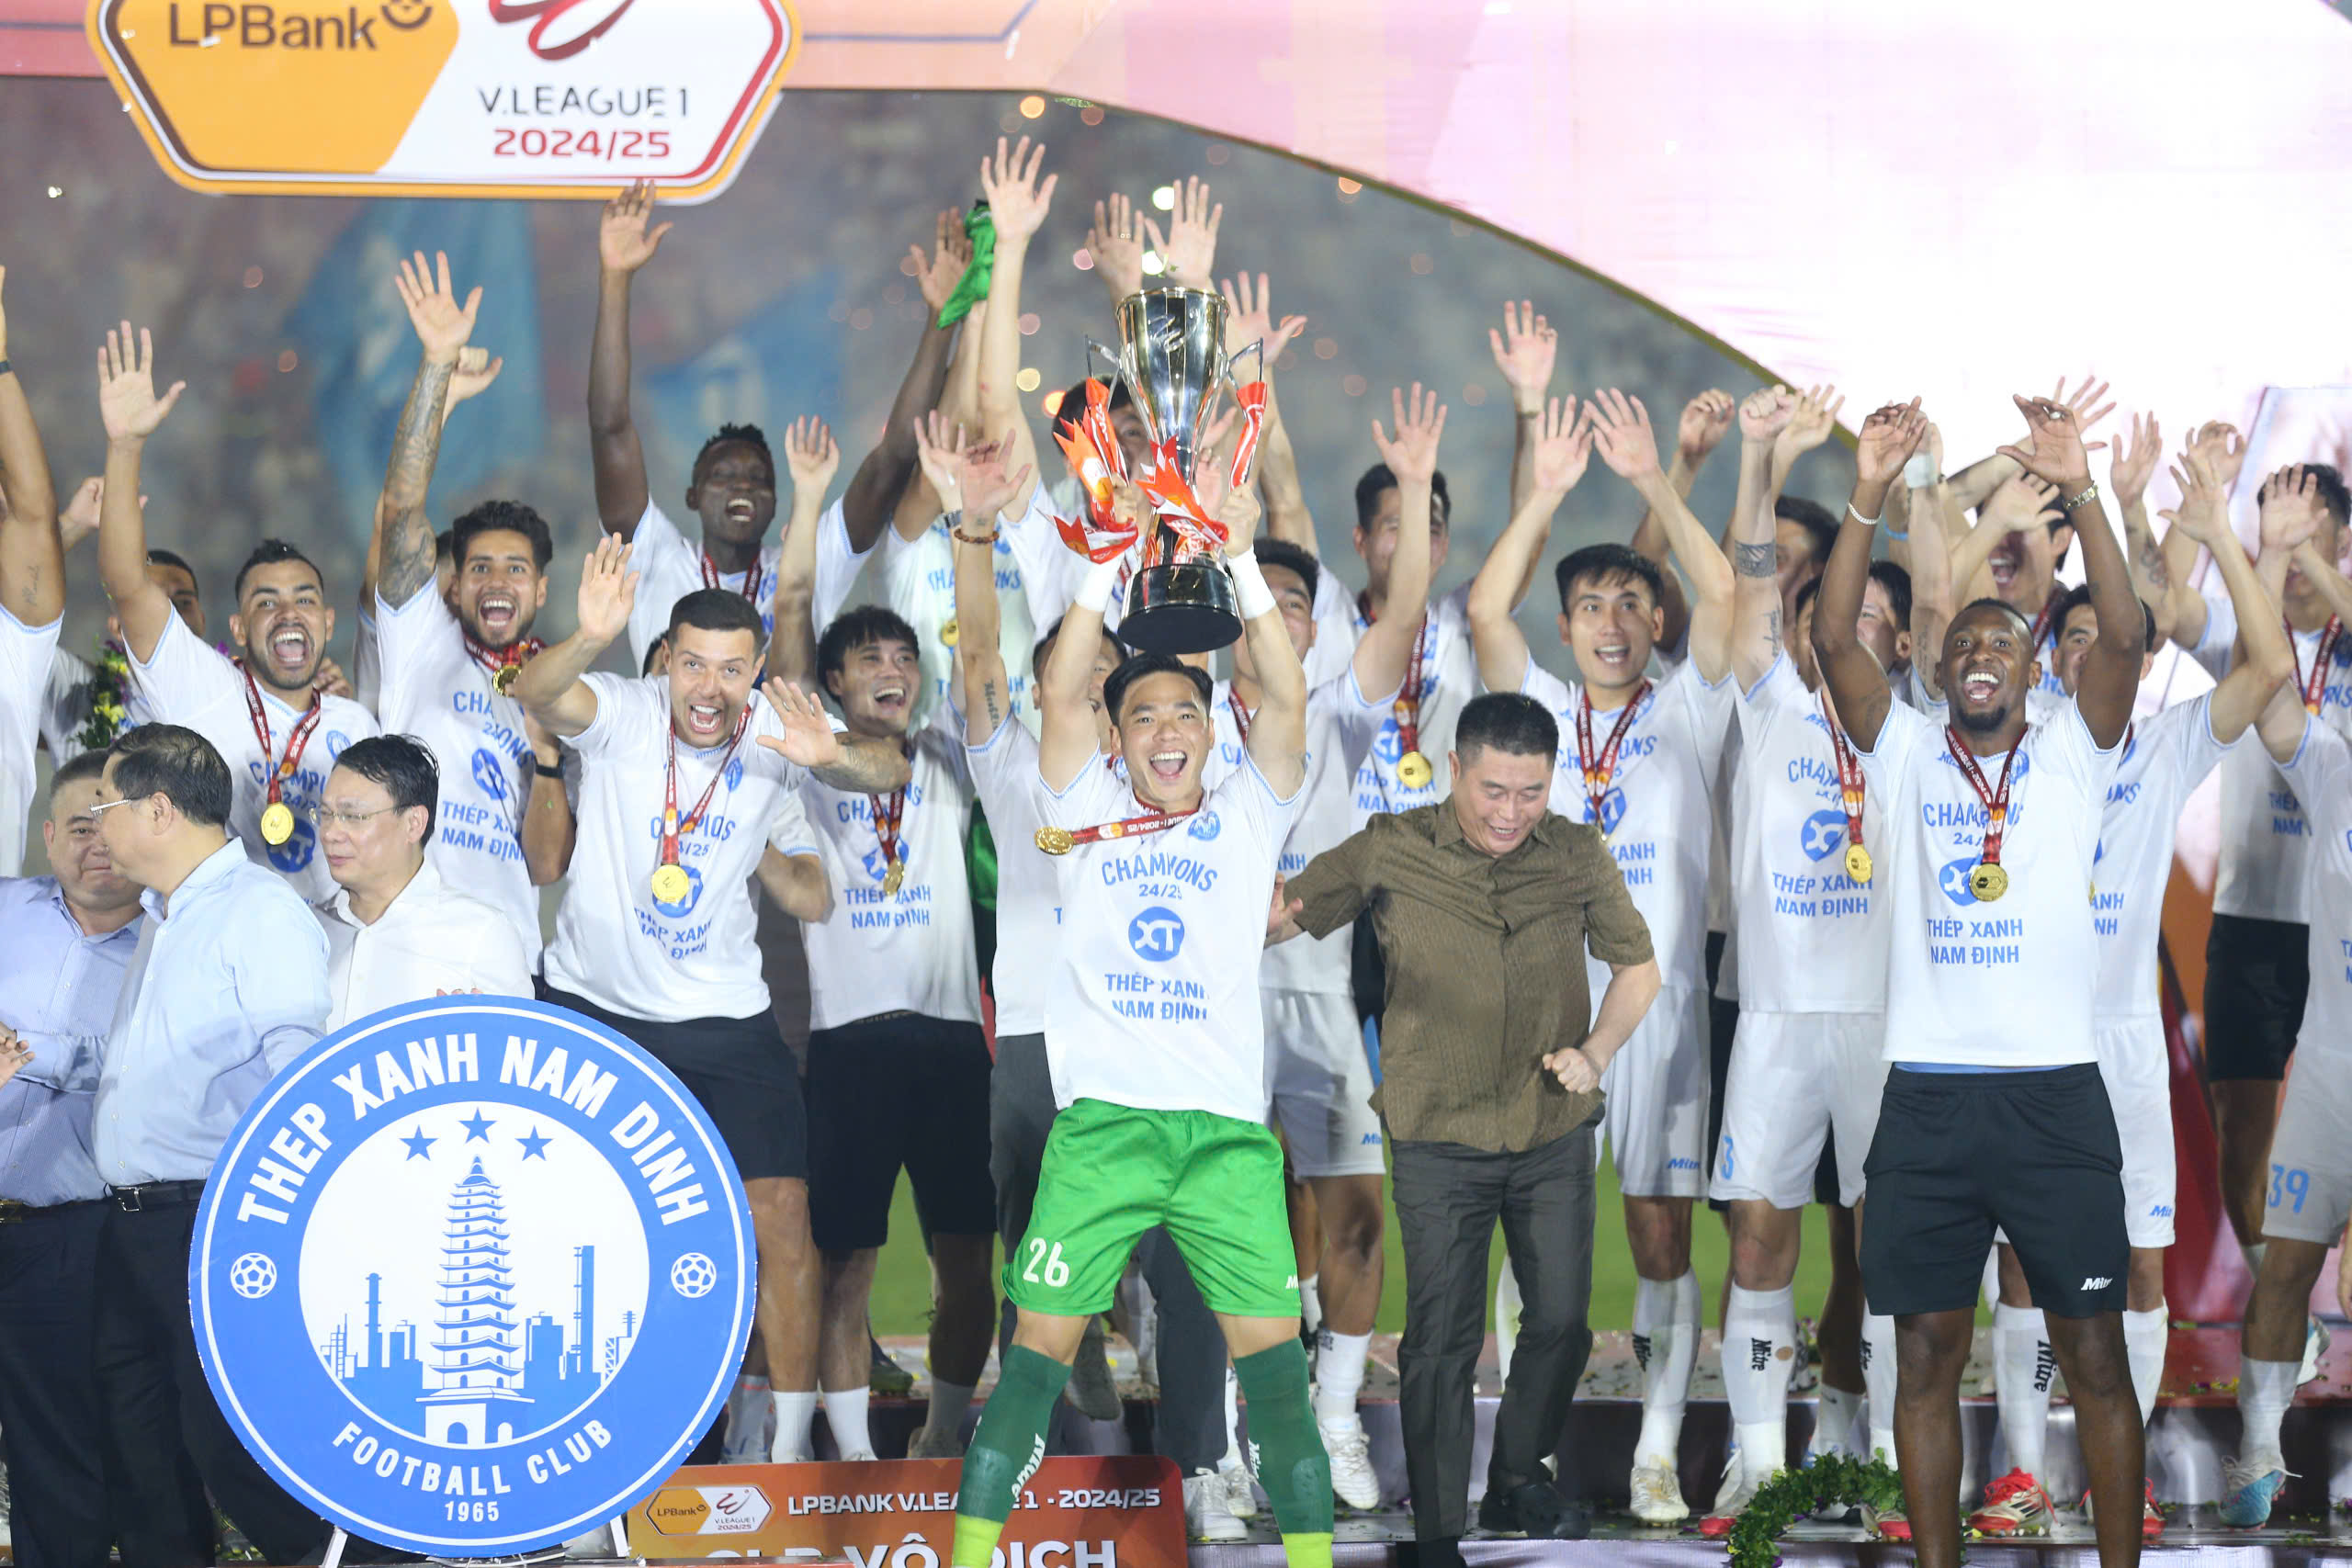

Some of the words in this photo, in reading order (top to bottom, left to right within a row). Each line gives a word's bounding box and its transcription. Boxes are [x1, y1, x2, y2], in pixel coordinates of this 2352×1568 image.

[169, 2, 377, 51] LPBank
[478, 85, 665, 118] V.LEAGUE
[680, 89, 688, 117] 1
[493, 130, 671, 159] 2024/25
[441, 827, 483, 851] NAM
[852, 910, 890, 929] NAM
[1775, 897, 1816, 918] NAM
[1822, 897, 1869, 919] ĐỊNH
[1970, 918, 2024, 938] XANH
[1930, 946, 1967, 965] NAM
[1971, 945, 2020, 969] ĐỊNH
[236, 1103, 333, 1224] THEP
[331, 1033, 480, 1121] XANH
[499, 1035, 619, 1120] NAM
[609, 1100, 710, 1225] DINH
[2267, 1163, 2311, 1215] 39
[1023, 1238, 1070, 1287] 26
[1750, 1337, 1772, 1371] Mitre
[2033, 1339, 2058, 1393] Mitre
[333, 1421, 512, 1496] FOOTBALL
[526, 1418, 613, 1485] CLUB
[445, 1500, 501, 1523] 1965
[657, 1507, 697, 1517] LPBank
[788, 1492, 895, 1516] LPBANK
[1023, 1491, 1039, 1509] 1
[1057, 1488, 1161, 1510] 2024/25
